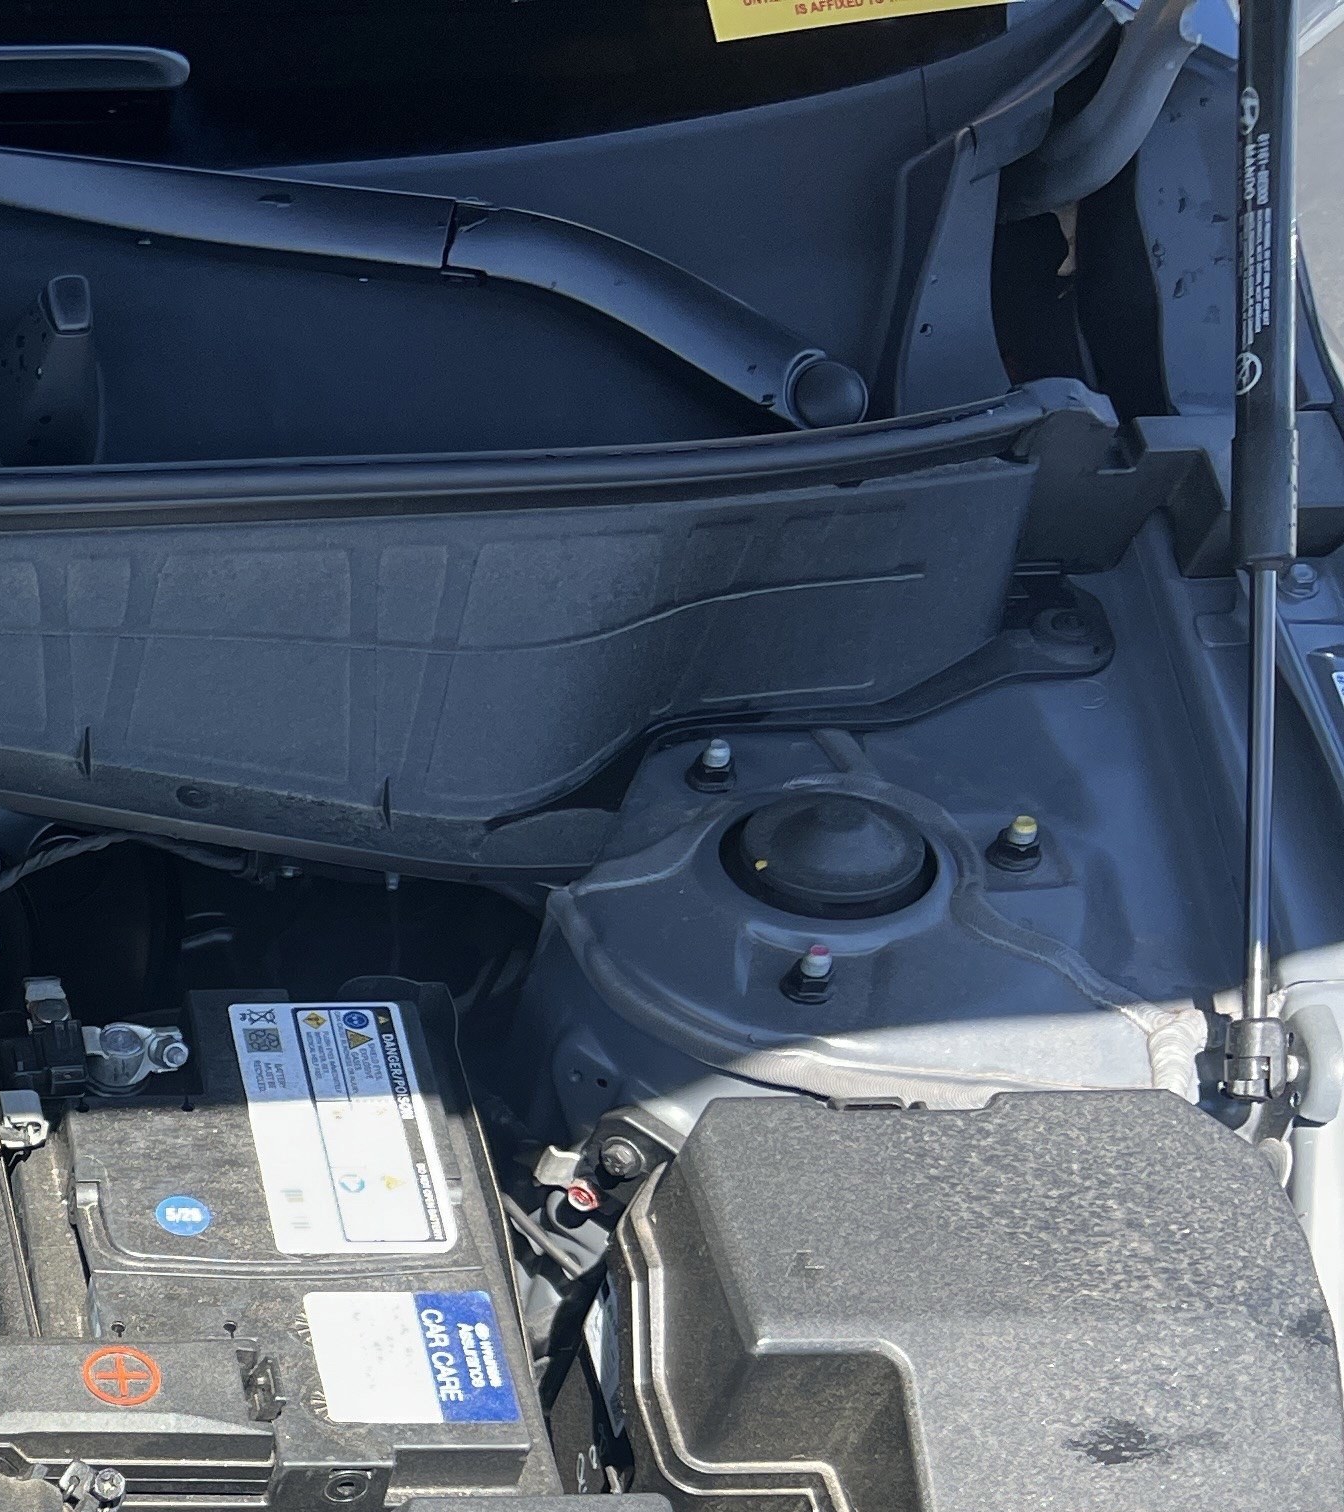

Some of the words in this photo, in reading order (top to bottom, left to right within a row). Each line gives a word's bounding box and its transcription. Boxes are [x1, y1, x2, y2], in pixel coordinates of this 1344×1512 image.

[794, 4, 807, 15] IS
[810, 0, 864, 13] AFFIXED
[382, 1033, 413, 1120] DANGER/POISON
[420, 1309, 449, 1347] CAR
[431, 1352, 464, 1402] CARE
